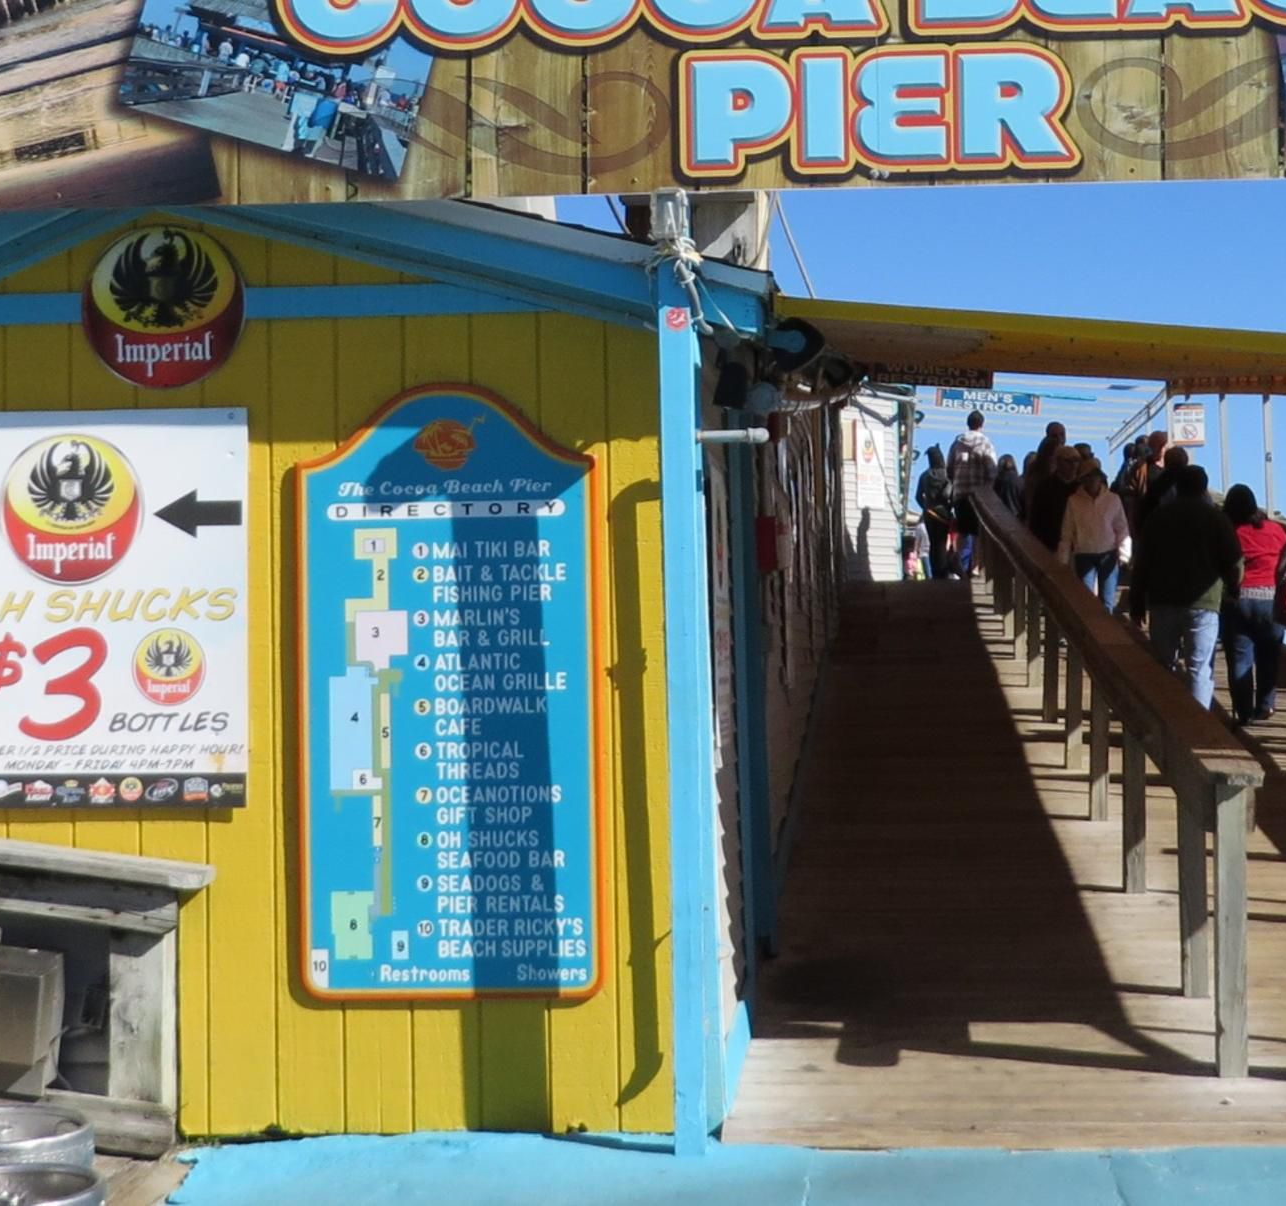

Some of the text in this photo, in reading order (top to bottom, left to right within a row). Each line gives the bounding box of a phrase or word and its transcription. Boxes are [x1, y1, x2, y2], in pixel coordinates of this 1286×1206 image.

[683, 46, 1079, 175] PIER
[115, 331, 212, 378] Imperial
[877, 372, 987, 387] RESTROOM
[963, 391, 1013, 403] MEN'S
[942, 399, 1033, 415] RESTROOM
[338, 478, 552, 497] The Cocoa Beach Pier
[335, 500, 558, 518] DIRECTORY
[26, 532, 115, 575] Imperial
[370, 541, 377, 551] 1
[432, 542, 468, 559] MAI
[474, 540, 508, 557] TIKI
[514, 540, 551, 557] BAR
[376, 570, 385, 581] 2
[417, 563, 567, 583] 2 BAIT & TACKLE
[433, 584, 552, 603] FISHING PIER
[43, 587, 238, 623] SHUCKS
[417, 608, 521, 627] 3 MARLIN'S
[371, 627, 380, 638] 3
[433, 628, 551, 648] BAR & GRILL
[417, 653, 521, 671] 4 ATLANTIC
[147, 679, 191, 701] Imperial
[435, 672, 567, 692] OCEAN GRILLE
[418, 697, 547, 715] 5 BOARDWALK
[108, 711, 230, 734] BOTTLES
[351, 712, 359, 723] 4
[381, 727, 390, 738] 5
[435, 718, 481, 736] CAFE
[19, 745, 42, 756] 1/2
[43, 744, 87, 756] PRICE
[90, 744, 146, 756] DURING
[149, 744, 197, 754] HAPPY
[200, 743, 244, 754] HOUR!
[419, 741, 524, 760] 6 TROPICAL
[3, 760, 61, 771] MONDAY
[74, 759, 126, 770] FRIDAY
[436, 762, 520, 780] THREADS
[359, 774, 367, 786] 6
[420, 785, 562, 803] 7 OCEANOTIONS
[373, 817, 382, 828] 7
[437, 806, 533, 825] GIFT SHOP
[437, 831, 461, 848] OH
[468, 830, 539, 847] SHUCKS
[438, 850, 565, 869] SEAFOOD BAR
[420, 875, 544, 893] 9 SEADOGS &
[438, 895, 564, 914] PIER RENTALS
[419, 918, 583, 937] 10 TRADER RICKY'S
[397, 941, 405, 952] 9
[438, 939, 586, 958] BEACH SUPPLIES
[313, 961, 326, 972] 10
[380, 964, 587, 983] Restrooms Showers
